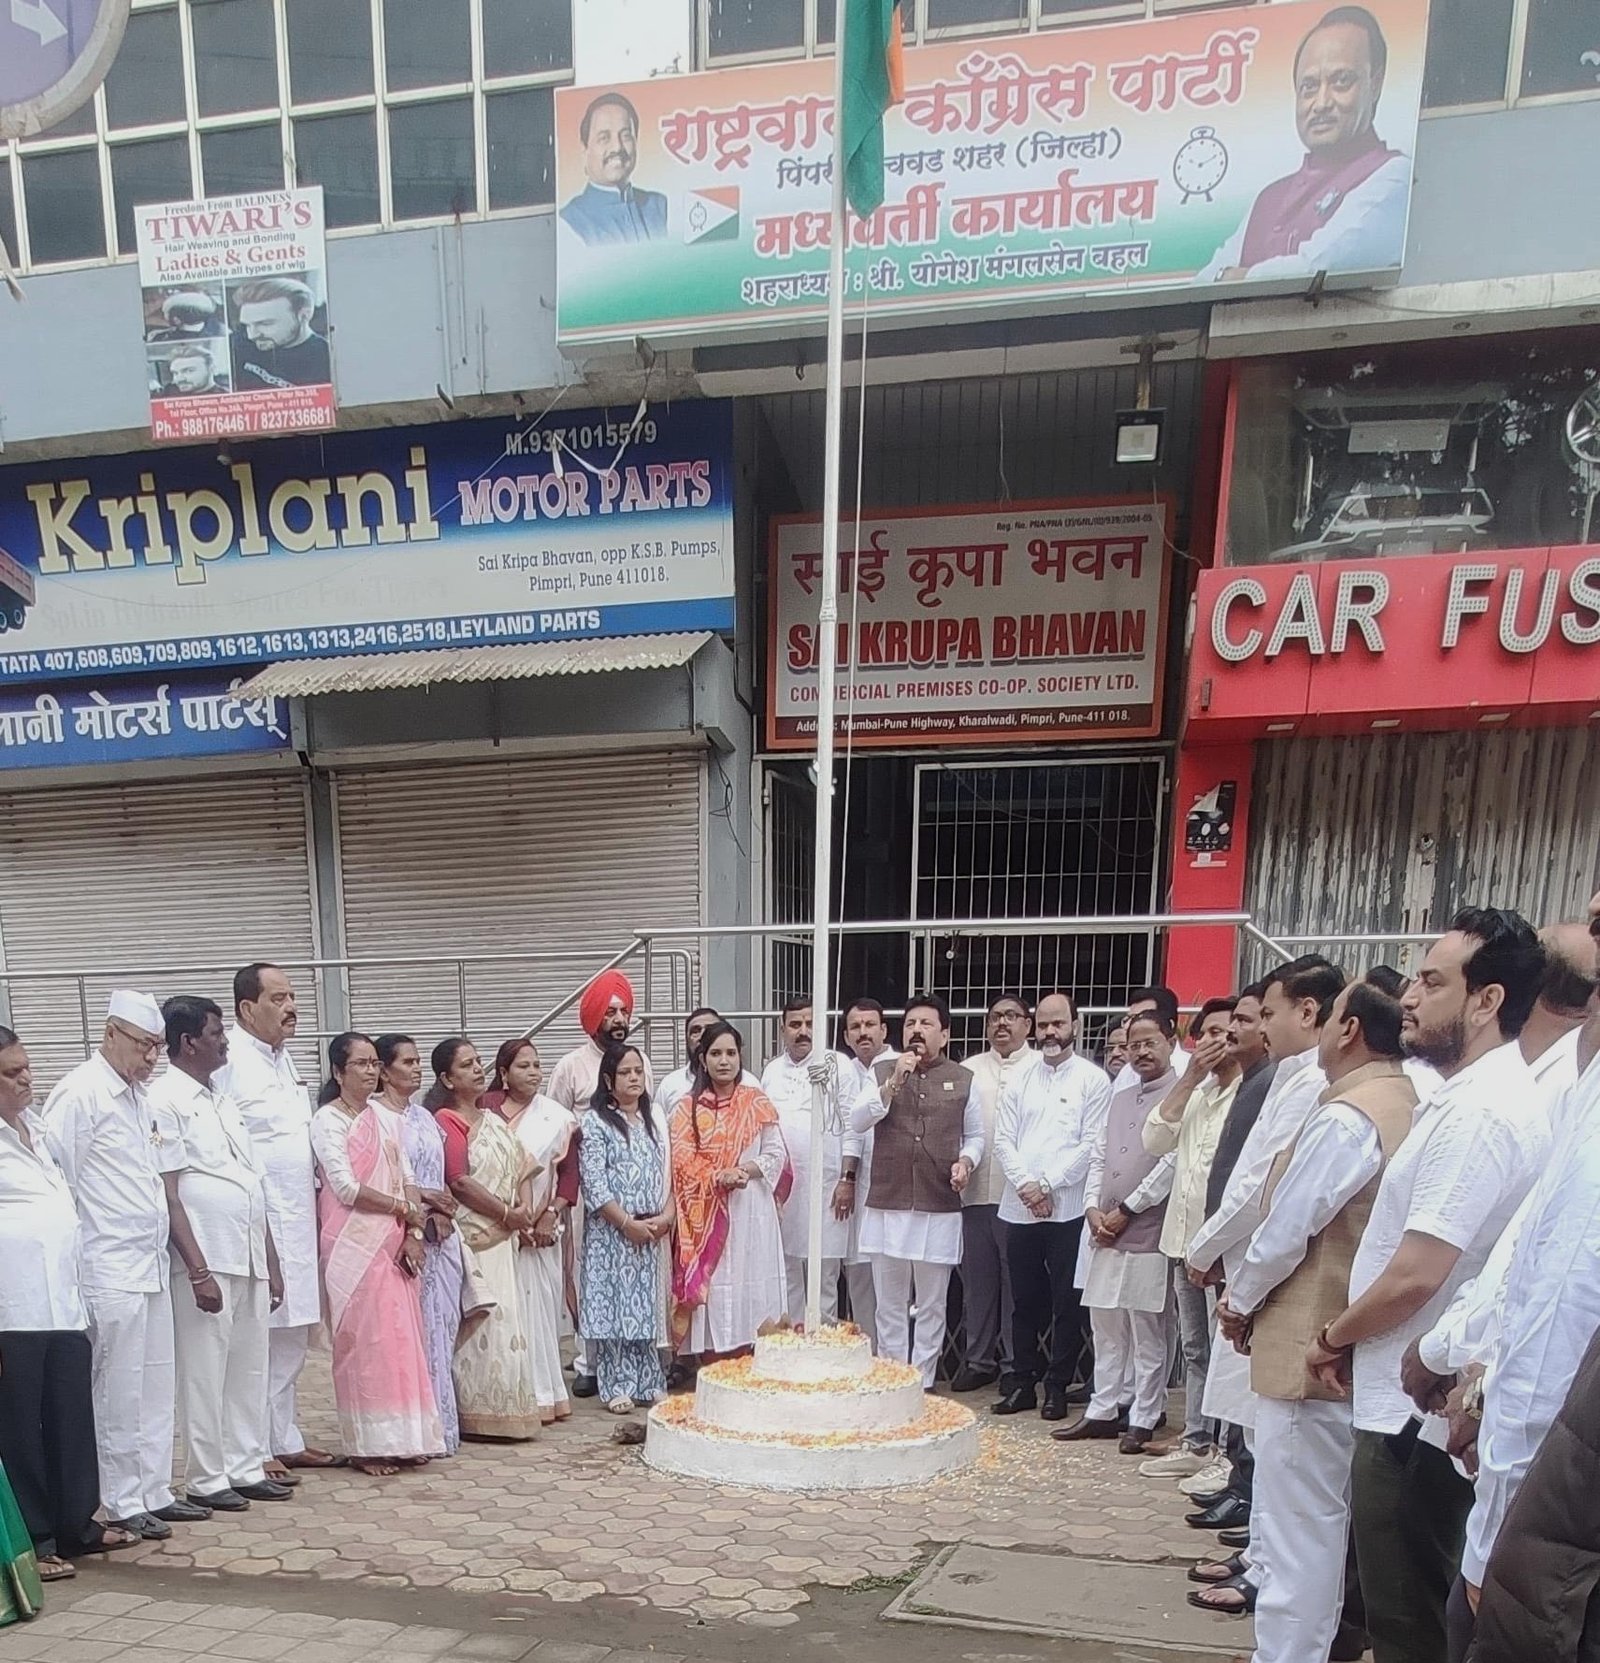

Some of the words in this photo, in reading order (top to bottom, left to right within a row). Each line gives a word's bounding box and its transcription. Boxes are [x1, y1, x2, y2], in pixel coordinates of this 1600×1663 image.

[904, 53, 1092, 134] काँग्रेस
[1112, 31, 1257, 112] पार्टी
[953, 143, 1006, 172] शहर
[1015, 127, 1122, 169] (जिल्हा)
[145, 200, 313, 242] TIWARI'S
[164, 202, 206, 216] Freedom
[207, 198, 233, 211] From
[235, 191, 292, 207] BALDNESS
[951, 168, 1159, 237] कार्यालय
[156, 252, 220, 273] Ladies
[224, 248, 241, 265] &
[246, 243, 306, 264] Gents
[164, 243, 185, 253] Hair
[187, 238, 230, 252] Weaving
[232, 235, 251, 246] and
[253, 232, 296, 245] Bonding
[870, 260, 904, 290] श्री.
[911, 252, 979, 284] योगेश
[986, 240, 1085, 279] मंगलसेन
[160, 271, 182, 282] Also
[184, 266, 229, 281] Available
[231, 265, 243, 275] all
[245, 263, 273, 276] types
[275, 261, 287, 270] of
[288, 259, 306, 272] wig
[181, 412, 251, 436] 9881764461
[260, 404, 331, 429] 8237336681
[457, 470, 591, 526] MOTOR
[598, 459, 712, 514] PARTS
[25, 445, 442, 586] Kriplani
[478, 554, 499, 572] Sai
[501, 551, 538, 573] Kripa
[541, 547, 598, 569] Bhavan,
[600, 545, 628, 566] opp
[630, 541, 667, 560] K.S.B.
[670, 538, 721, 560] Pumps,
[906, 542, 1009, 608] कृपा
[1026, 535, 1149, 583] भवन
[529, 574, 576, 594] Pimpri,
[579, 569, 613, 589] Pune
[615, 566, 670, 585] 411018.
[857, 614, 983, 666] KRUPA
[992, 609, 1147, 659] BHAVAN
[1210, 570, 1391, 663] CAR
[0, 654, 42, 675] TATA
[540, 609, 601, 633] PARTS
[895, 680, 974, 699] PREMISES
[977, 677, 1033, 695] CO-OP.
[1037, 674, 1101, 693] SOCIETY
[1105, 673, 1140, 690] LTD.
[72, 683, 171, 740] मोटर्स
[910, 711, 956, 731] Highway,
[1020, 708, 1055, 727] Pimpri,
[1058, 707, 1106, 725] Pune-411
[1108, 708, 1131, 722] 018.
